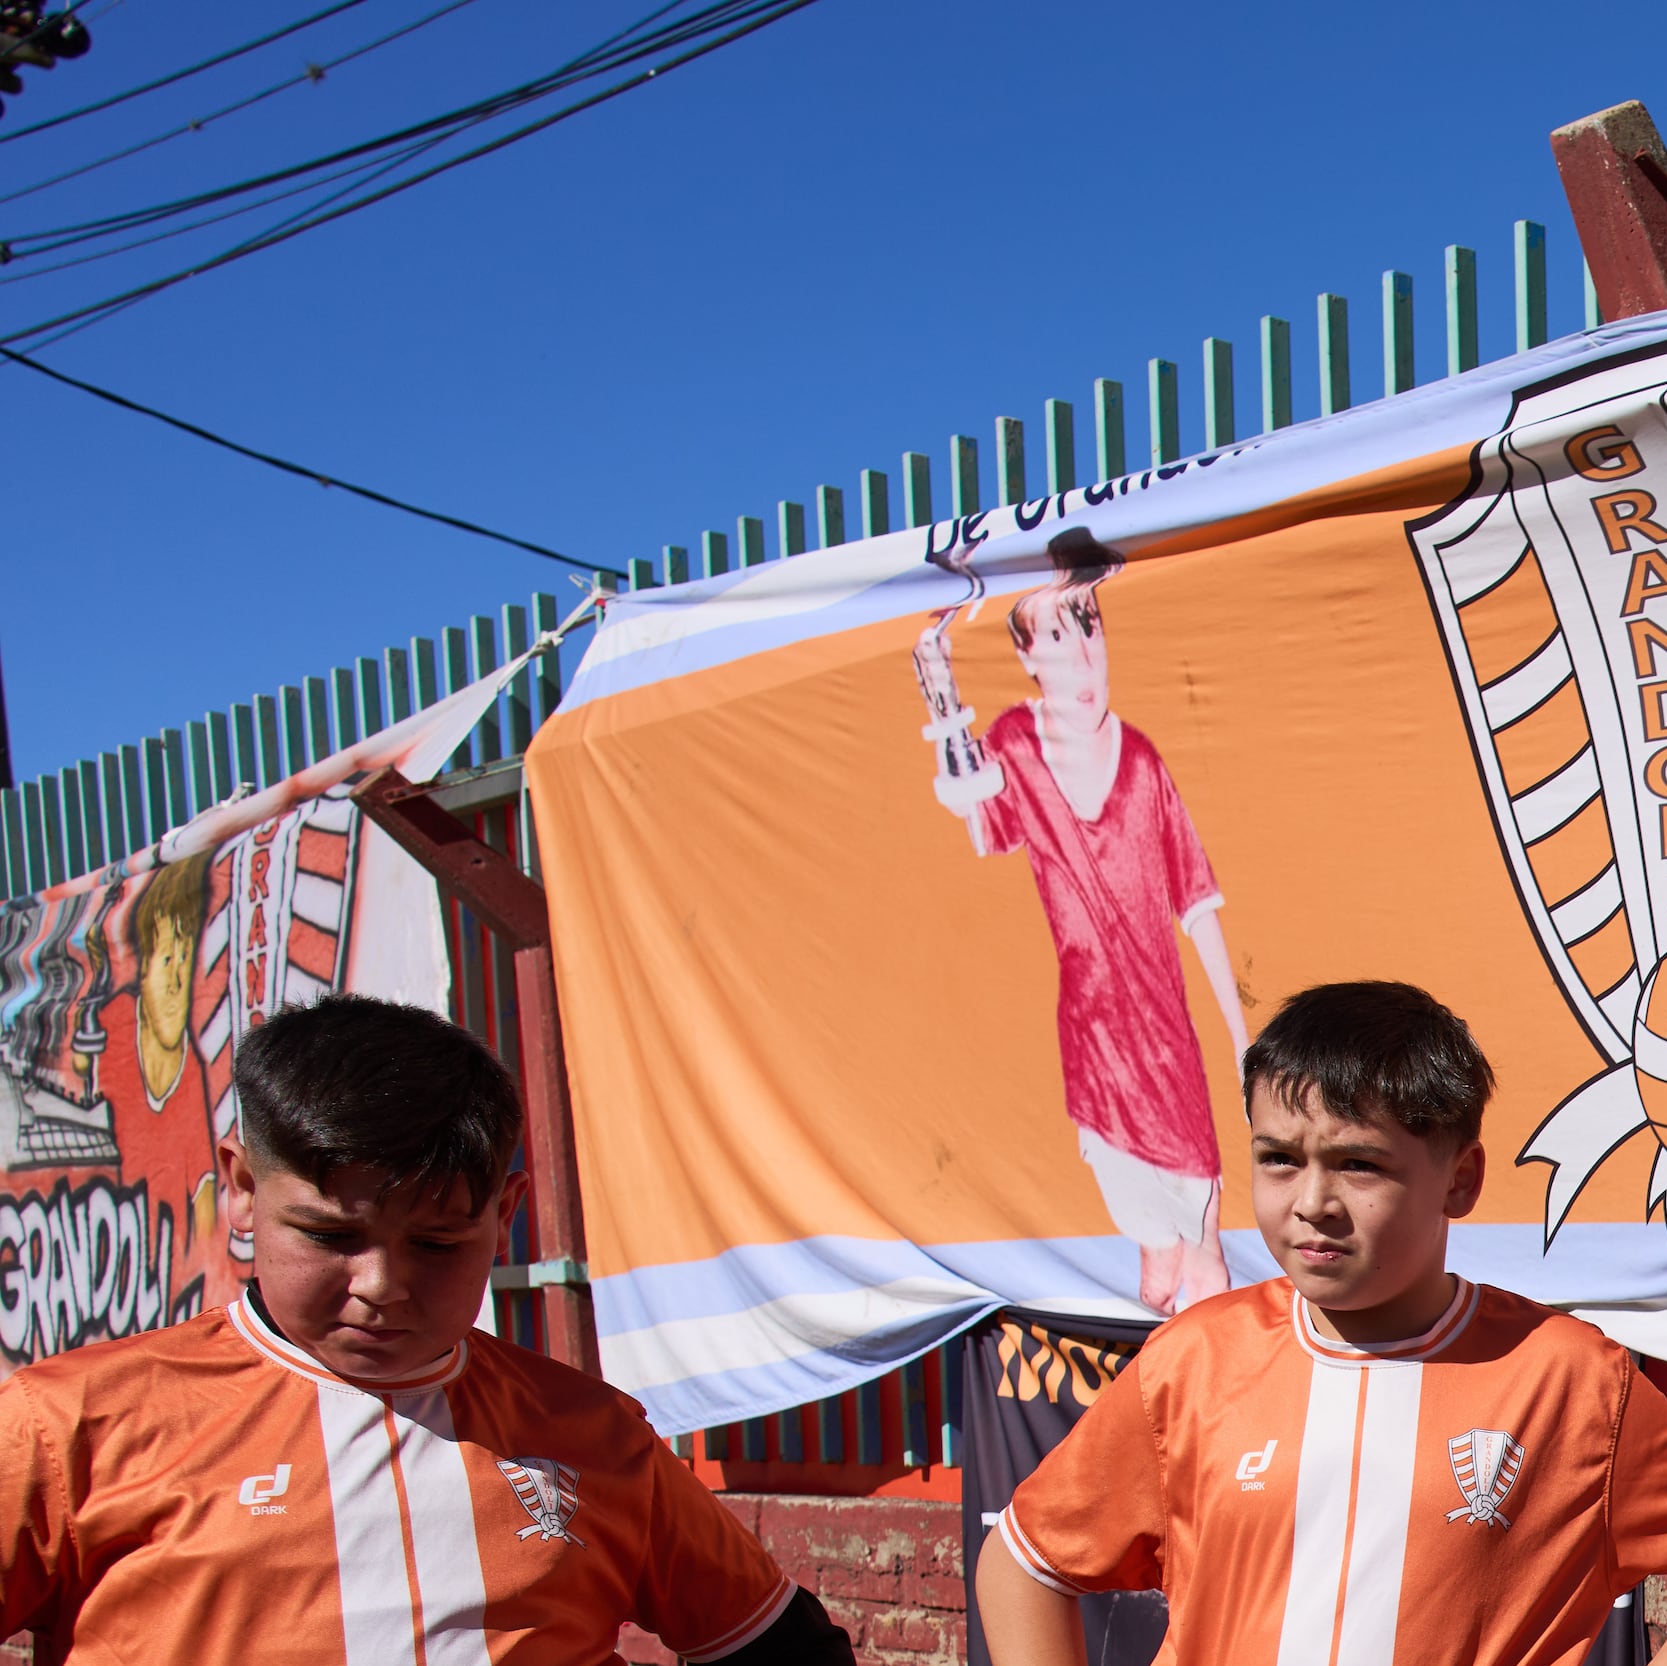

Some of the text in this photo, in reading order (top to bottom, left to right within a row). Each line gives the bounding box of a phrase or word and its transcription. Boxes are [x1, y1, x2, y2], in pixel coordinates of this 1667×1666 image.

[0, 1178, 174, 1358] GRANDOLI
[1241, 1481, 1266, 1492] DARK
[250, 1505, 288, 1516] DARK
